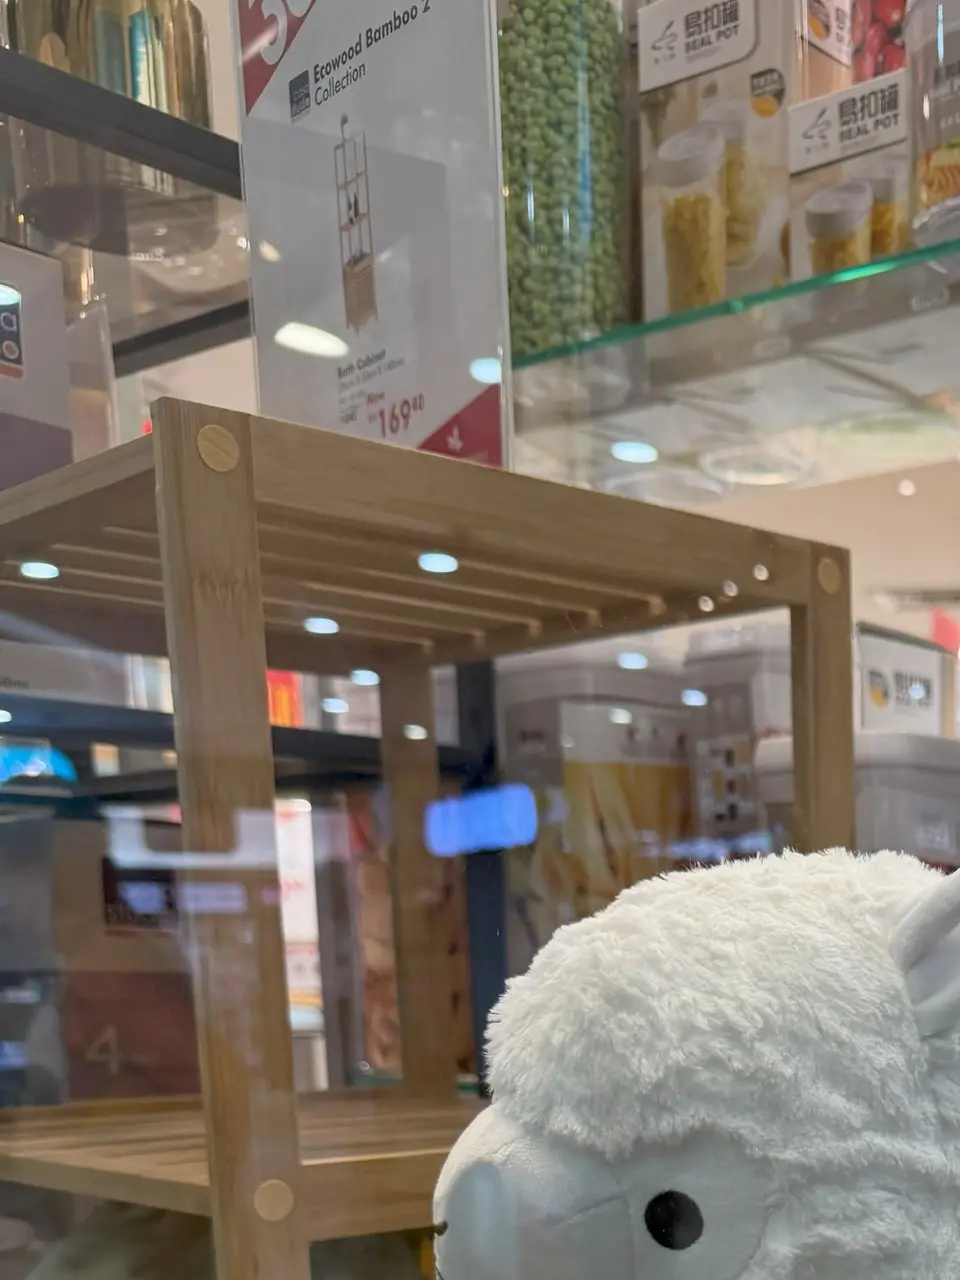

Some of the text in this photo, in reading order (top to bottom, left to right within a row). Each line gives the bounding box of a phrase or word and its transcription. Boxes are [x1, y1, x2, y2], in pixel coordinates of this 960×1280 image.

[314, 33, 363, 85] Ecowood
[365, 4, 418, 49] Bamboo
[314, 63, 367, 106] Collection
